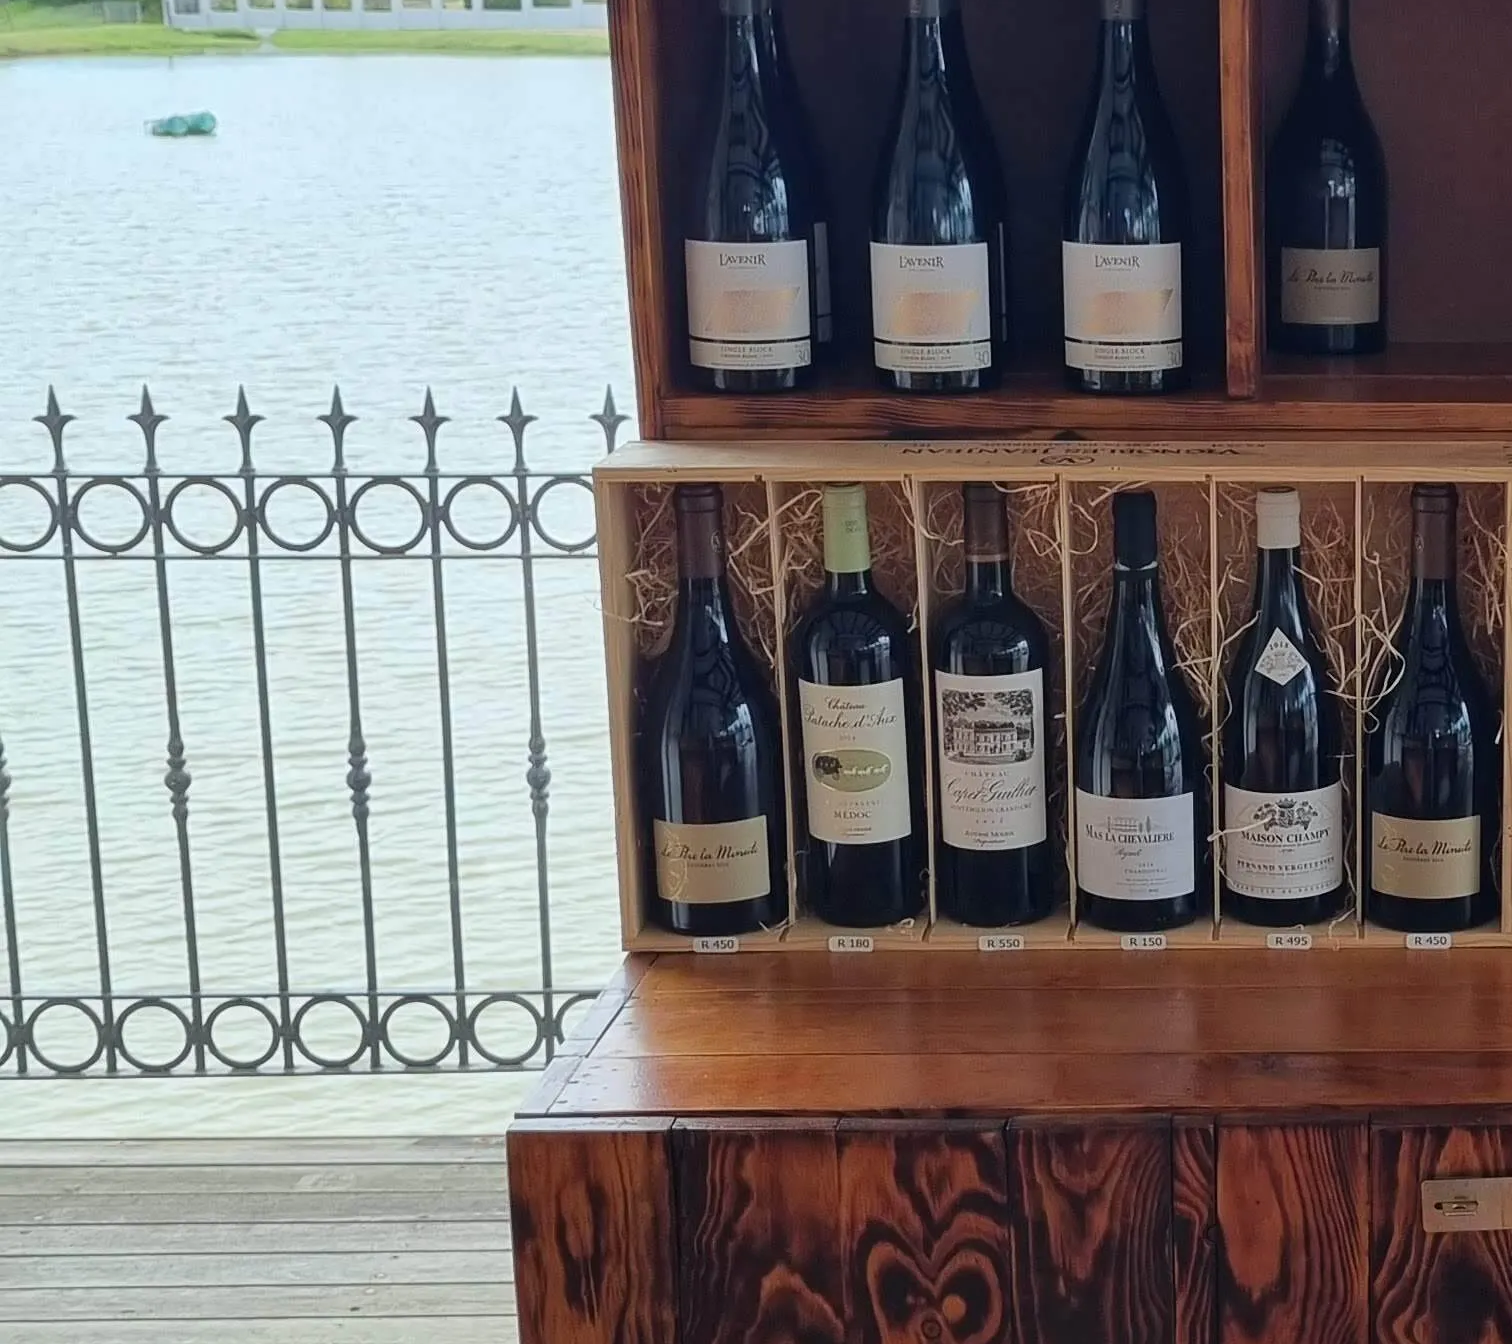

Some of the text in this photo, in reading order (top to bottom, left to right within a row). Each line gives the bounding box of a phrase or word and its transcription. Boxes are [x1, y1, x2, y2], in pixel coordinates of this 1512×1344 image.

[719, 253, 767, 267] L'AVENIR
[899, 255, 945, 269] L'AVENIR
[1095, 255, 1141, 268] L'AVENIR
[803, 704, 850, 729] Patache
[1086, 823, 1103, 840] MAS
[1105, 832, 1117, 844] LA
[1240, 827, 1331, 844] MAISON CHAMPY
[700, 938, 735, 950] R 450
[837, 938, 870, 949] R 180
[987, 938, 1020, 949] R 550
[1129, 937, 1163, 947] R 150
[1275, 936, 1308, 946] R 495
[1414, 935, 1447, 946] R 450
